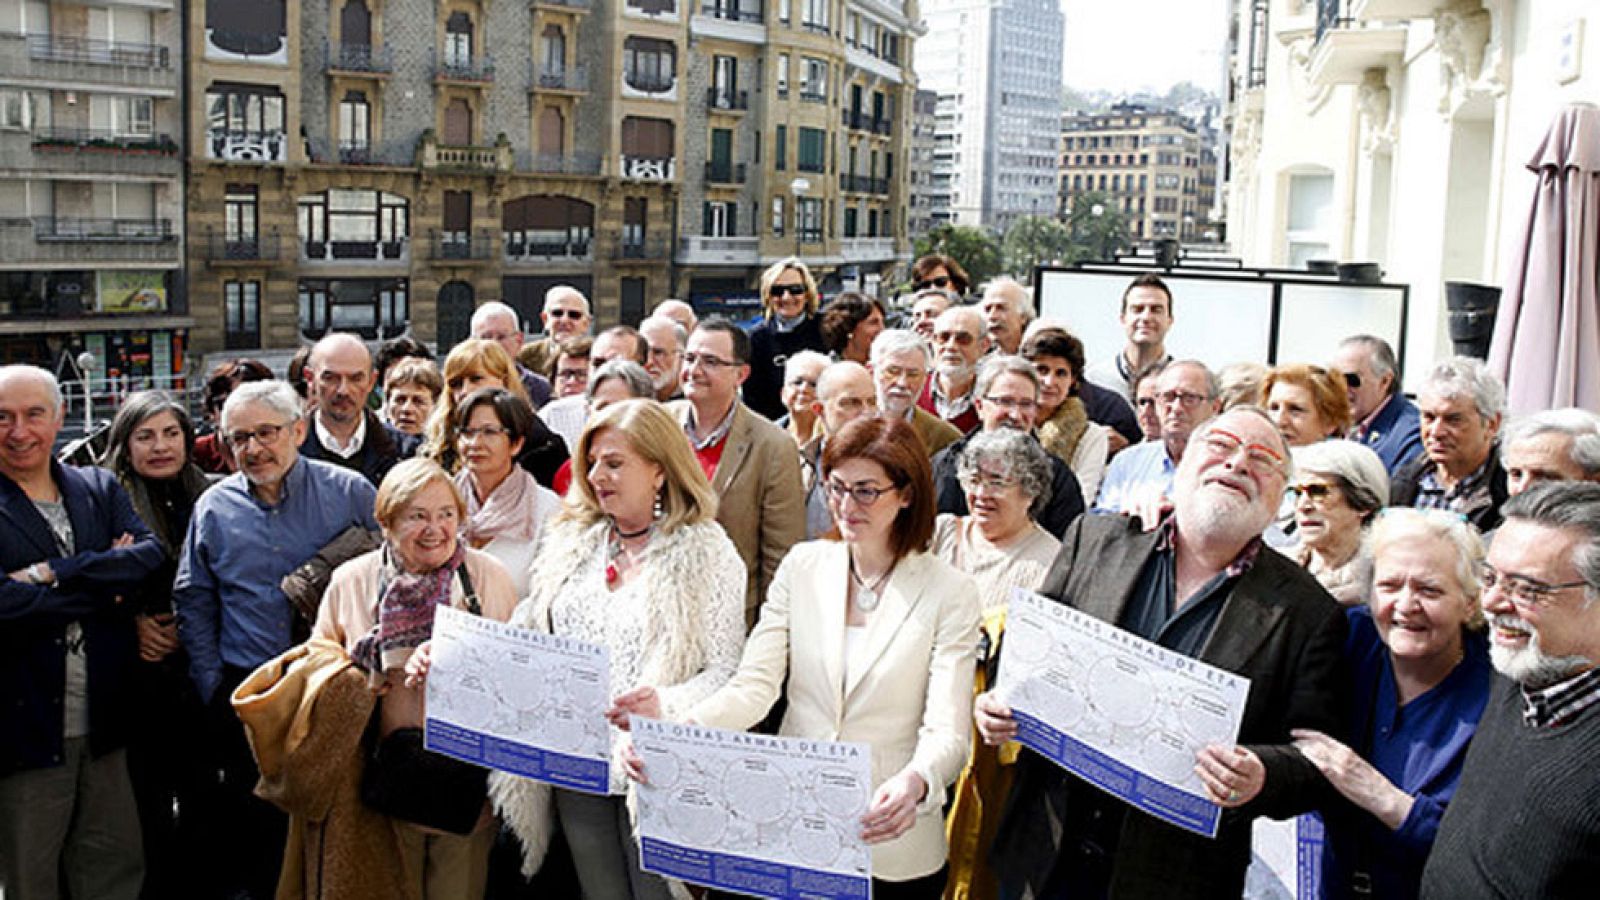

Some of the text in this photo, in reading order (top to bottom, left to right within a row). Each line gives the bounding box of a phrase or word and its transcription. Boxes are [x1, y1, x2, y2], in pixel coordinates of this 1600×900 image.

[1052, 605, 1101, 634] OTRAS
[1111, 631, 1165, 661] ARMAS
[1176, 657, 1195, 672] DE
[1207, 669, 1237, 689] ETA
[638, 721, 664, 733] LAS
[672, 725, 724, 742] OTRAS
[733, 734, 788, 751] ARMAS
[800, 741, 817, 754] DE
[829, 744, 859, 757] ETA
